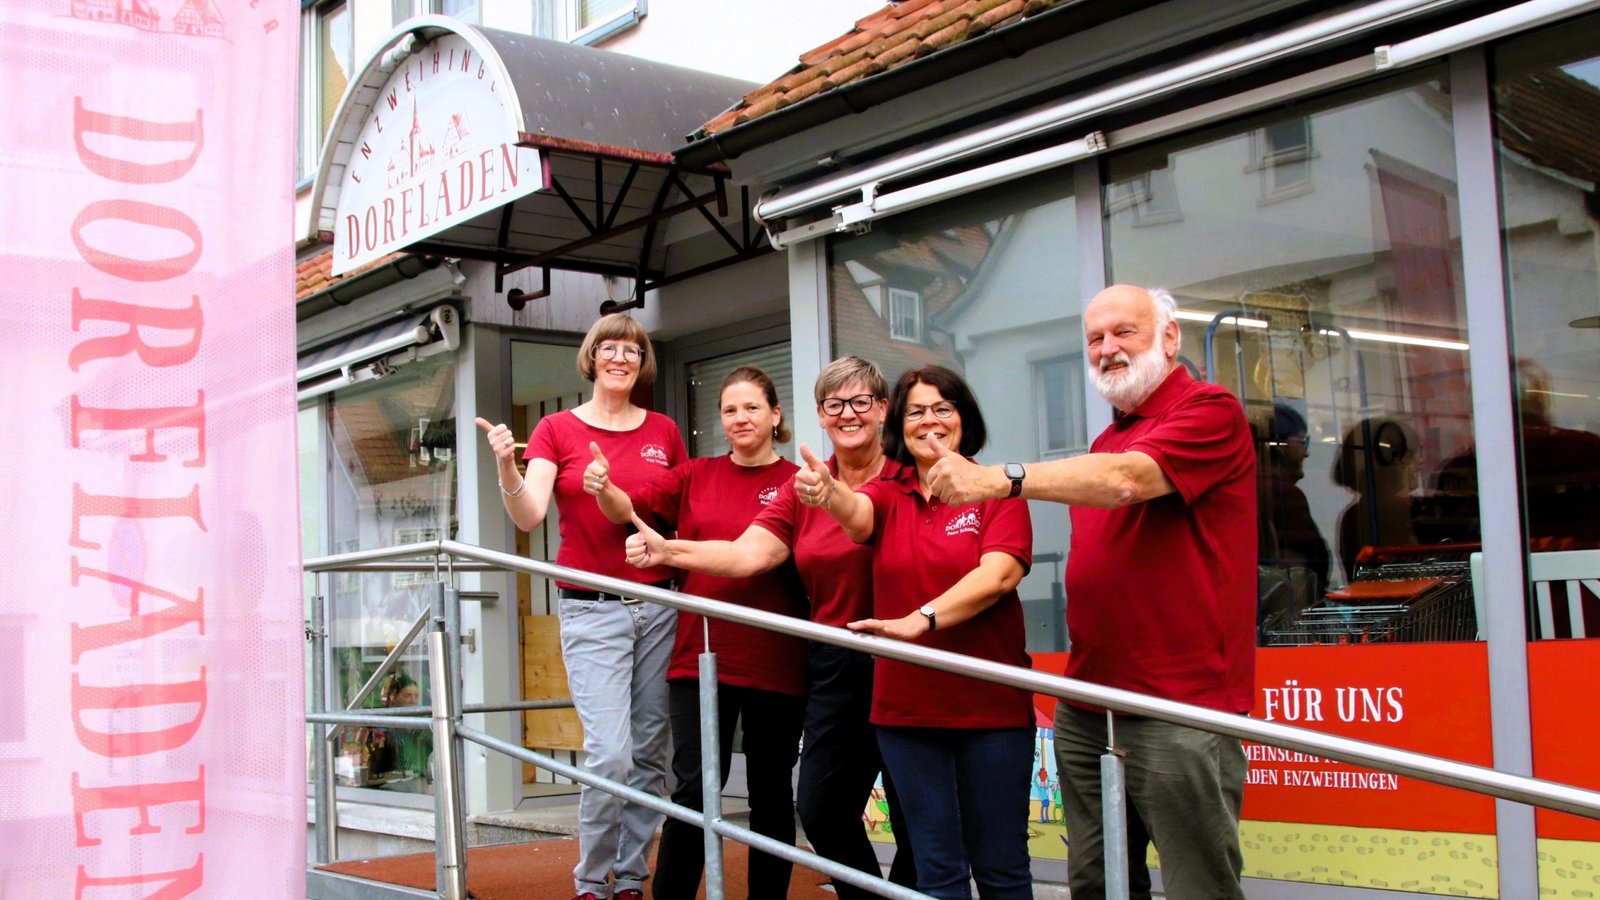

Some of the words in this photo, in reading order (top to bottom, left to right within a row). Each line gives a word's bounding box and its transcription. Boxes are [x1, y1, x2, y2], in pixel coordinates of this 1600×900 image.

[346, 143, 518, 260] DORFLADEN
[70, 96, 206, 900] DORFLADEN
[1262, 680, 1324, 721] FÜR
[1335, 687, 1404, 722] UNS
[1243, 768, 1278, 785] ADEN
[1283, 770, 1398, 790] ENZWEIHINGEN
